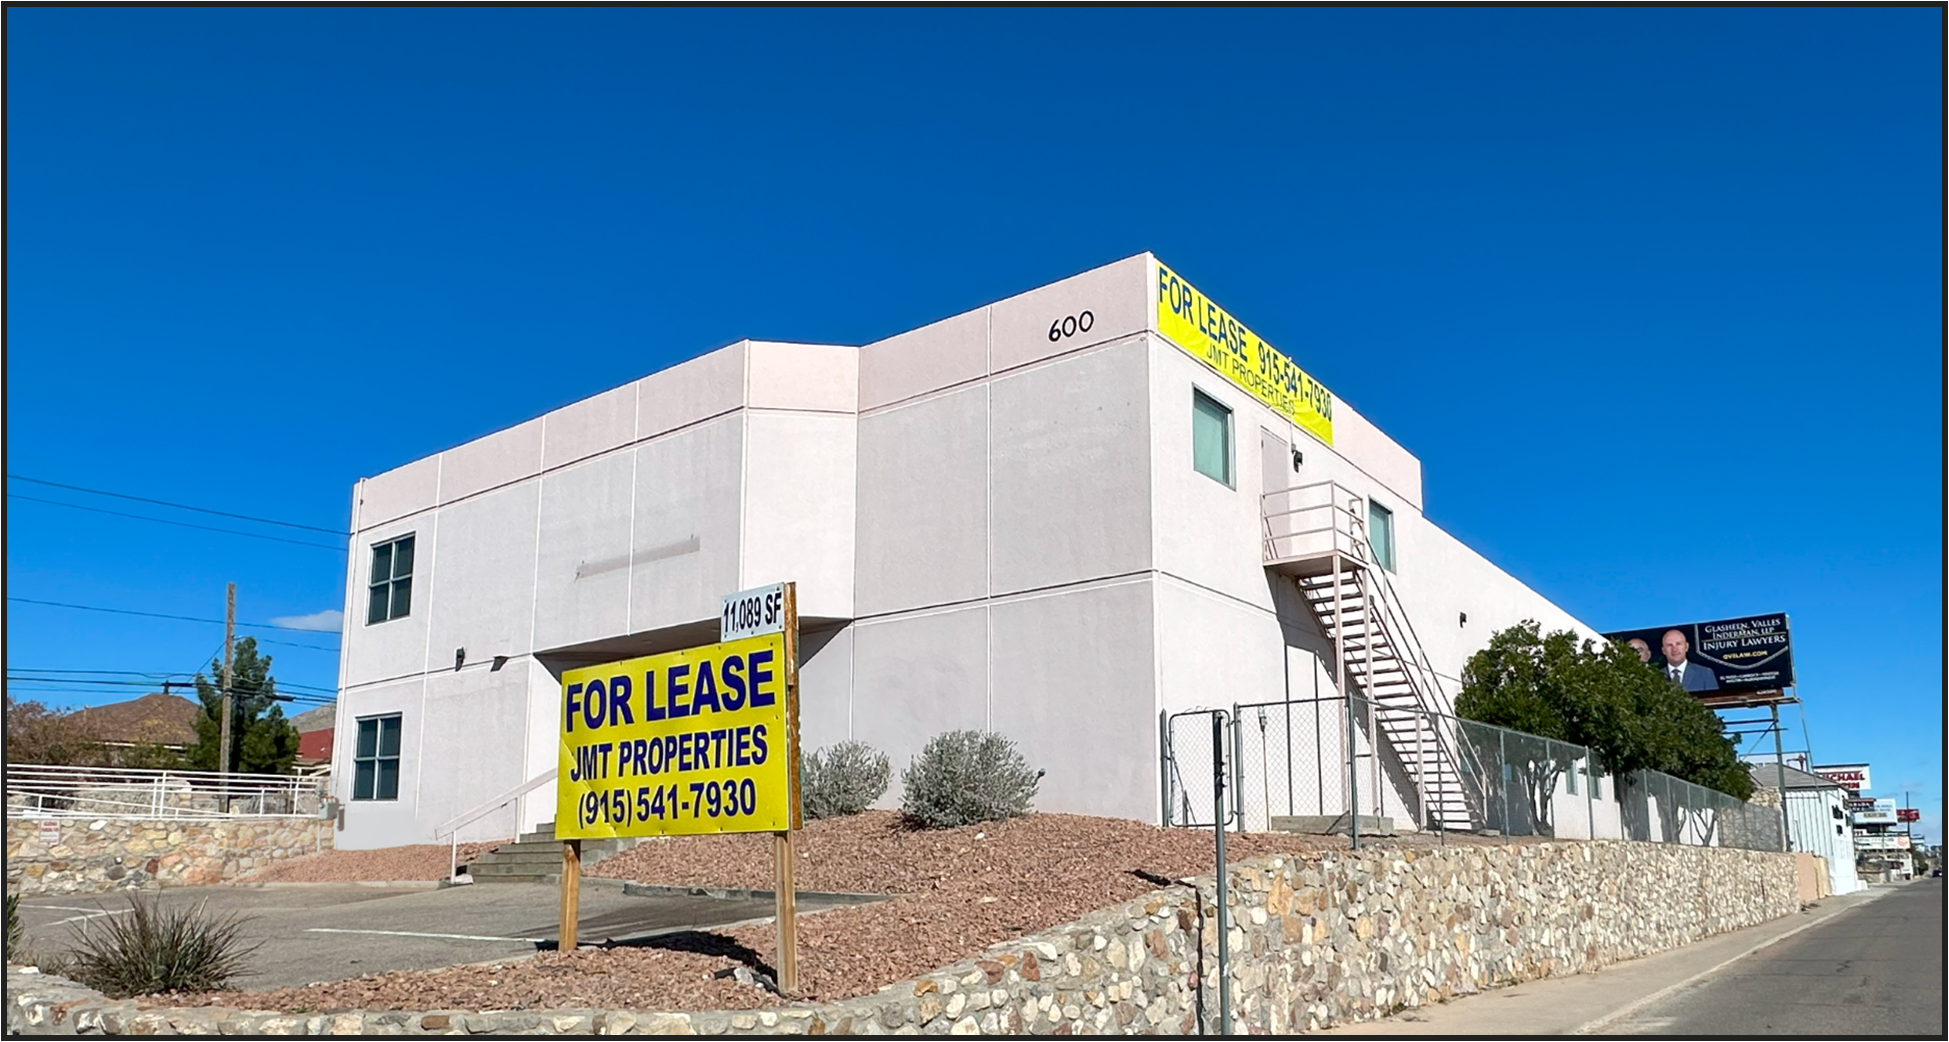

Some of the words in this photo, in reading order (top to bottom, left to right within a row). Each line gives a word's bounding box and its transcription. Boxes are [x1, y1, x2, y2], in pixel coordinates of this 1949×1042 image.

[1048, 310, 1094, 342] 600
[1158, 266, 1194, 325] FOR
[1197, 295, 1248, 363] LEASE
[1257, 341, 1332, 422] 915-541-7930
[1206, 343, 1229, 370] JMT
[1232, 358, 1295, 416] PROPERTIES
[723, 595, 761, 633] 11,089
[765, 591, 782, 625] SF
[1751, 618, 1781, 628] VALLES
[1703, 640, 1738, 651] INJURY
[1741, 635, 1786, 647] LAWYERS
[566, 675, 634, 733] FOR
[645, 650, 776, 722] LEASE
[570, 743, 612, 782] JMT
[618, 724, 768, 777] PROPERTIES
[578, 789, 632, 829] (915)
[636, 778, 756, 822] 541-7930
